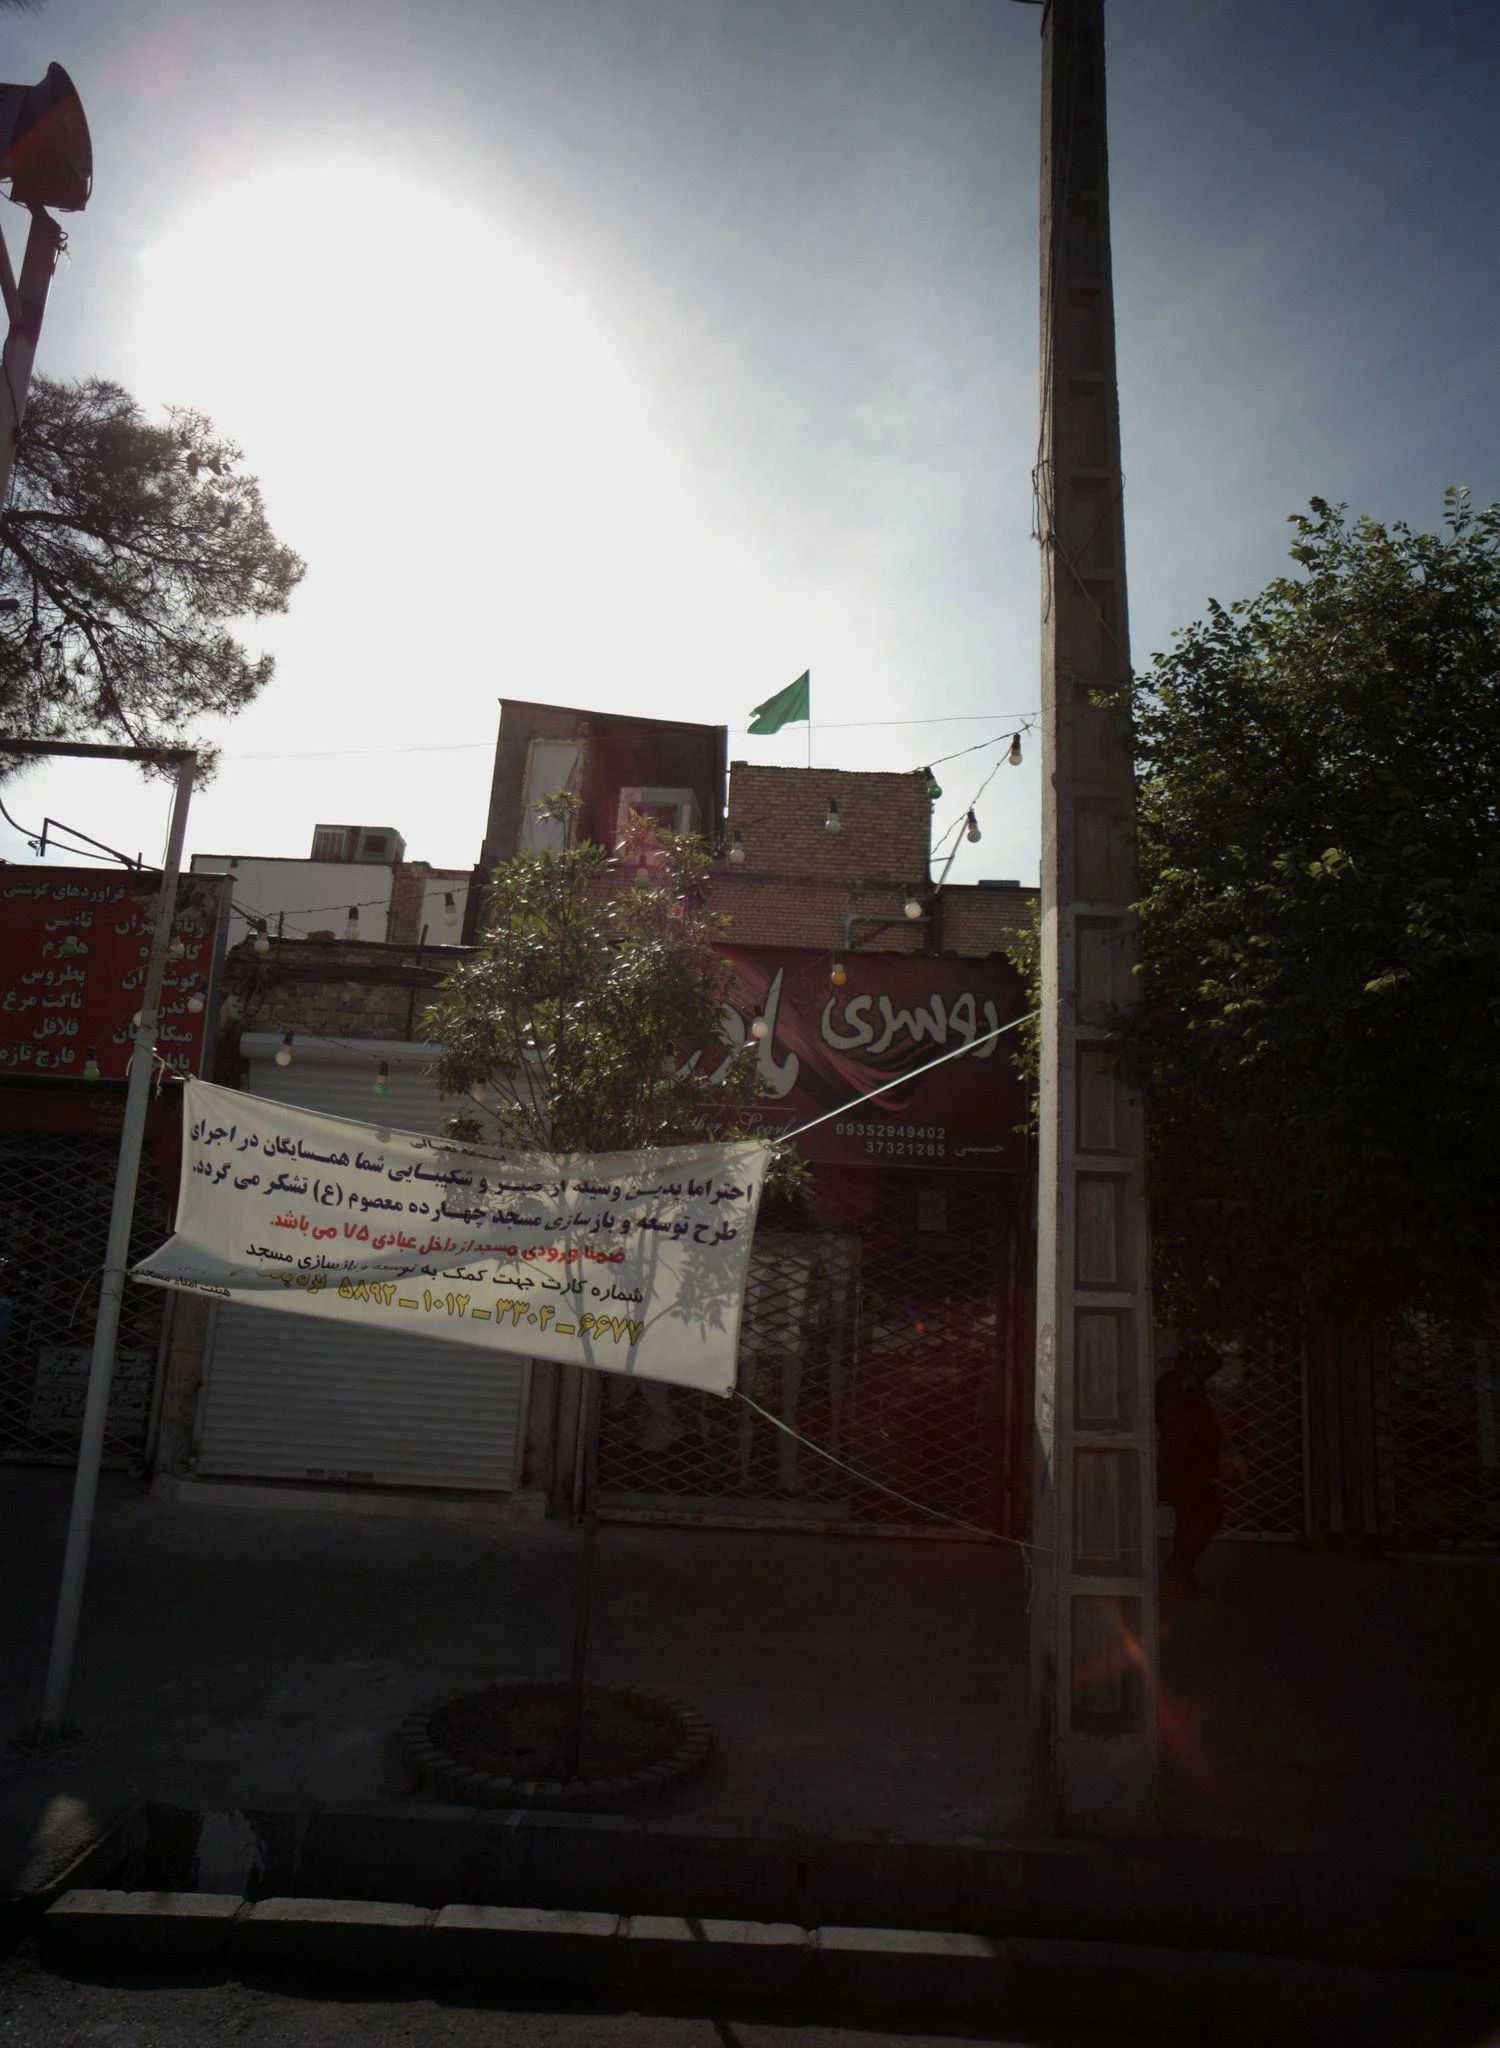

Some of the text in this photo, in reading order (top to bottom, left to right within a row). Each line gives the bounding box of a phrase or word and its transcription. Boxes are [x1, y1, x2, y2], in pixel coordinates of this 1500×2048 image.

[22, 965, 86, 988] پطروس
[2, 987, 37, 1013] مرغ
[33, 1016, 79, 1039] فلافل
[821, 992, 998, 1059] روسری
[0, 1043, 32, 1067] تازه
[190, 1119, 237, 1147] اجرای
[836, 1122, 946, 1140] 09352949402
[236, 1134, 259, 1152] در
[263, 1135, 350, 1168] همسایگان
[866, 1141, 946, 1156] 37321285
[355, 1151, 385, 1173] شما
[233, 1173, 260, 1190] می
[262, 1173, 309, 1196] تشکر
[478, 1177, 488, 1194] و
[550, 1179, 567, 1198] از
[573, 1179, 622, 1202] وسیله
[625, 1181, 682, 1202] بدین
[348, 1192, 404, 1213] معصوم
[491, 1209, 542, 1230] مسجد
[620, 1218, 631, 1234] و
[636, 1216, 690, 1241] توسعه
[311, 1225, 338, 1240] می
[372, 1231, 417, 1252] عبادی
[693, 1221, 738, 1246] طرح
[246, 1244, 294, 1263] مسجد
[418, 1235, 457, 1256] داخل
[454, 1240, 475, 1257] از
[473, 1242, 518, 1257] مسجد
[522, 1244, 579, 1264] ورودی
[584, 1244, 626, 1265] ضمنا
[420, 1264, 437, 1281] به
[443, 1268, 488, 1282] کمک
[493, 1275, 535, 1291] جهت
[541, 1278, 588, 1296] کارت
[591, 1284, 644, 1304] شماره
